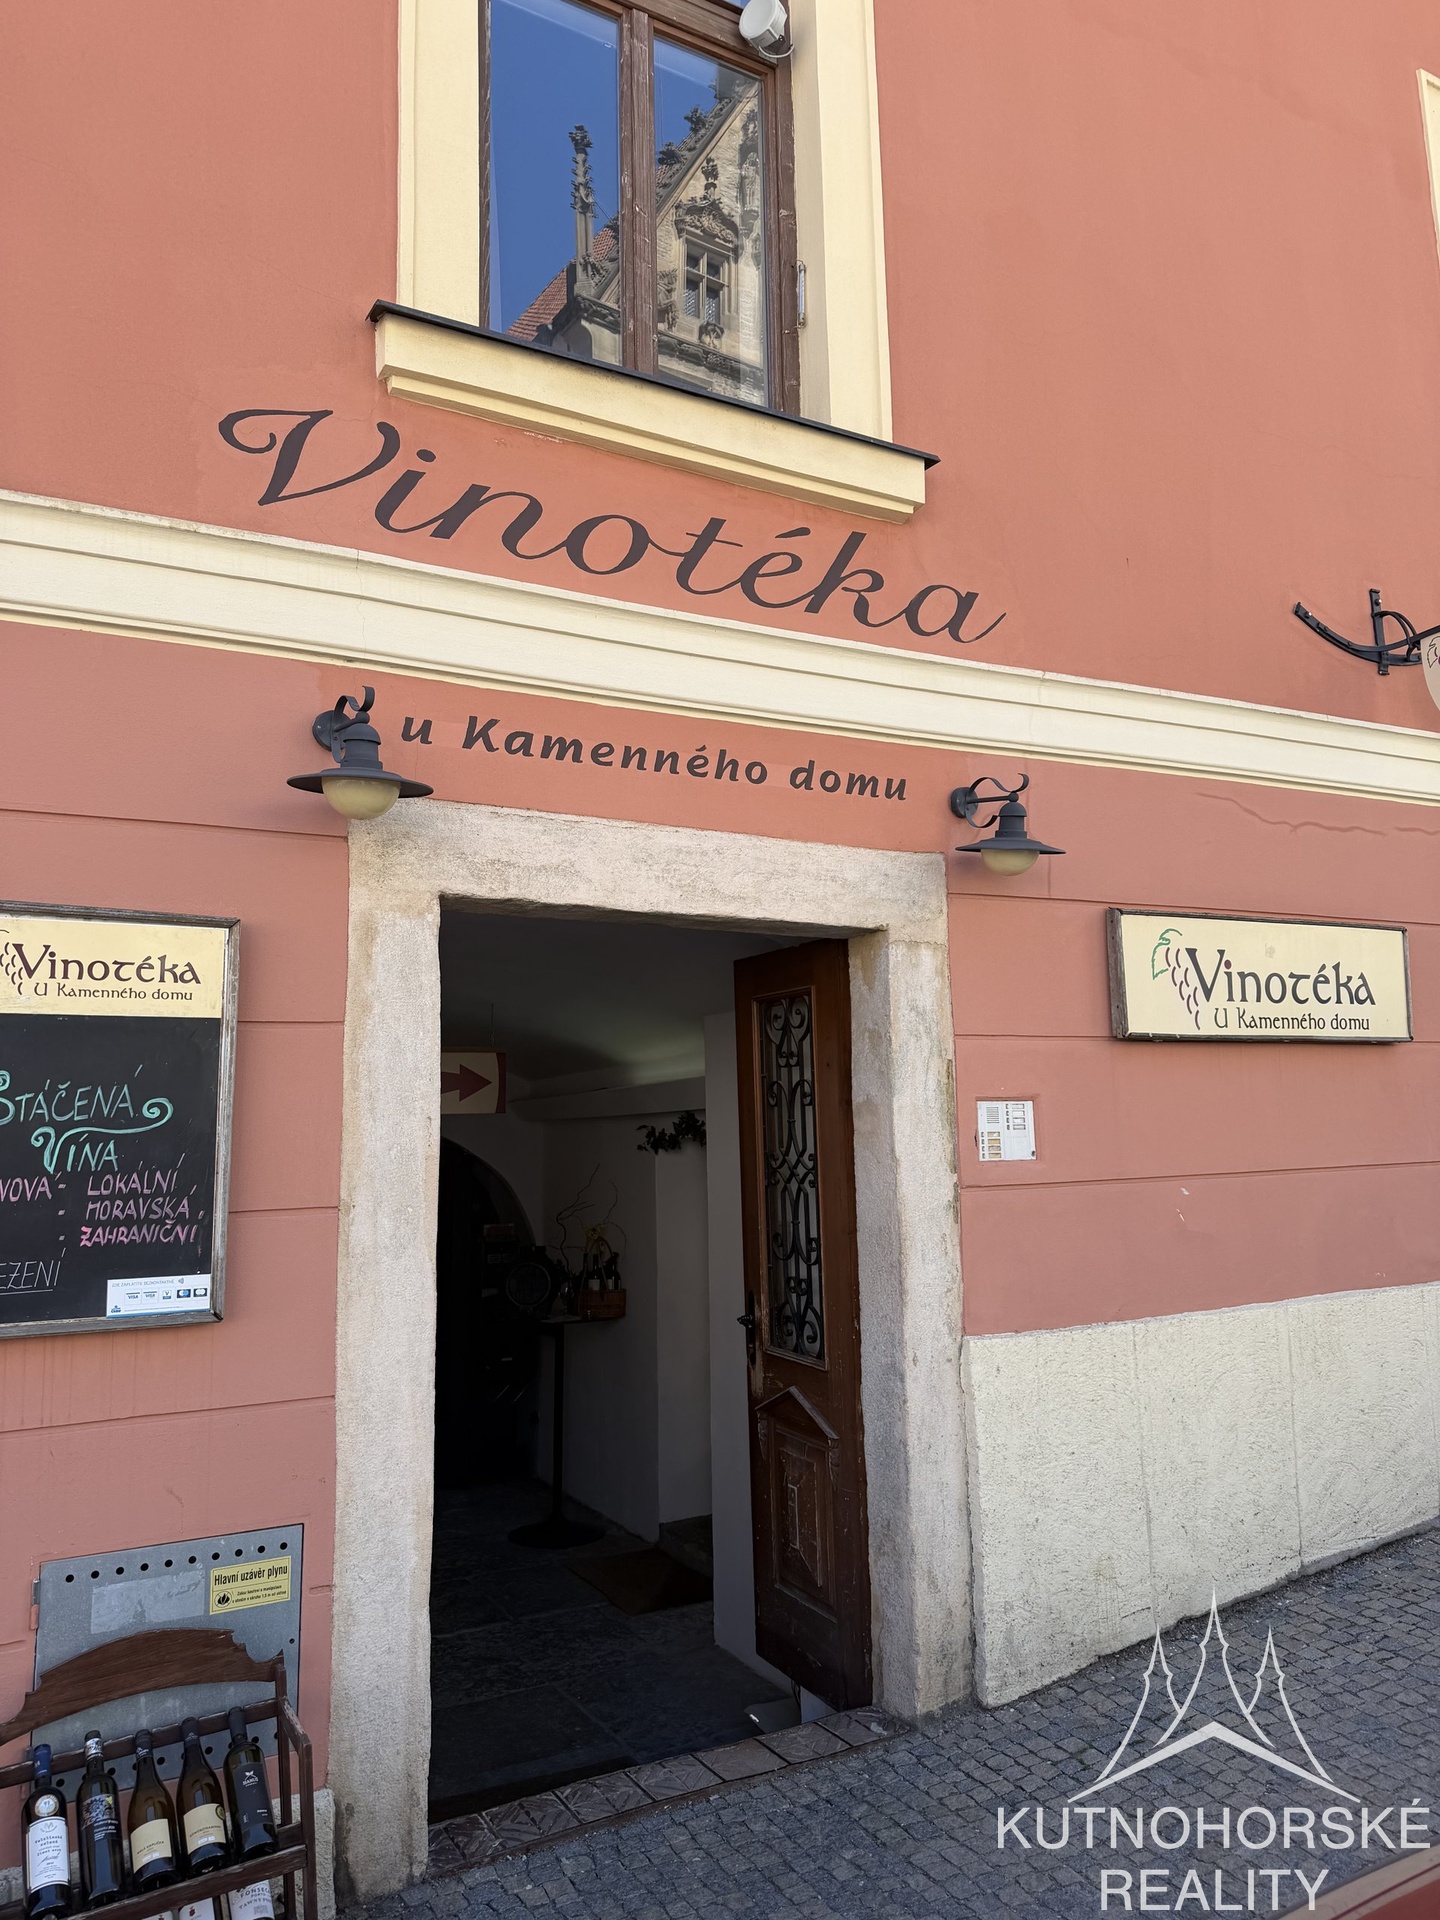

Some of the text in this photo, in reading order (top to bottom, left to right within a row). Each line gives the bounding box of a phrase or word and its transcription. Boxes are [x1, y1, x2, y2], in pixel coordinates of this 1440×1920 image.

[218, 409, 1005, 643] Vinotéka
[401, 715, 908, 800] u Kamenného domu
[12, 943, 201, 984] Vinotéka
[1185, 947, 1376, 1006] Vinotéka
[34, 982, 193, 1000] U Kamenného domu
[1214, 1007, 1370, 1031] U Kamenného domu
[31, 1126, 118, 1174] VÍNA
[87, 1153, 185, 1195] LOKÁLNÍ
[86, 1185, 197, 1221] MORAVSKÁ
[214, 1565, 288, 1585] Hlavní uzávěr plynu
[240, 1886, 269, 1898] FONSEC
